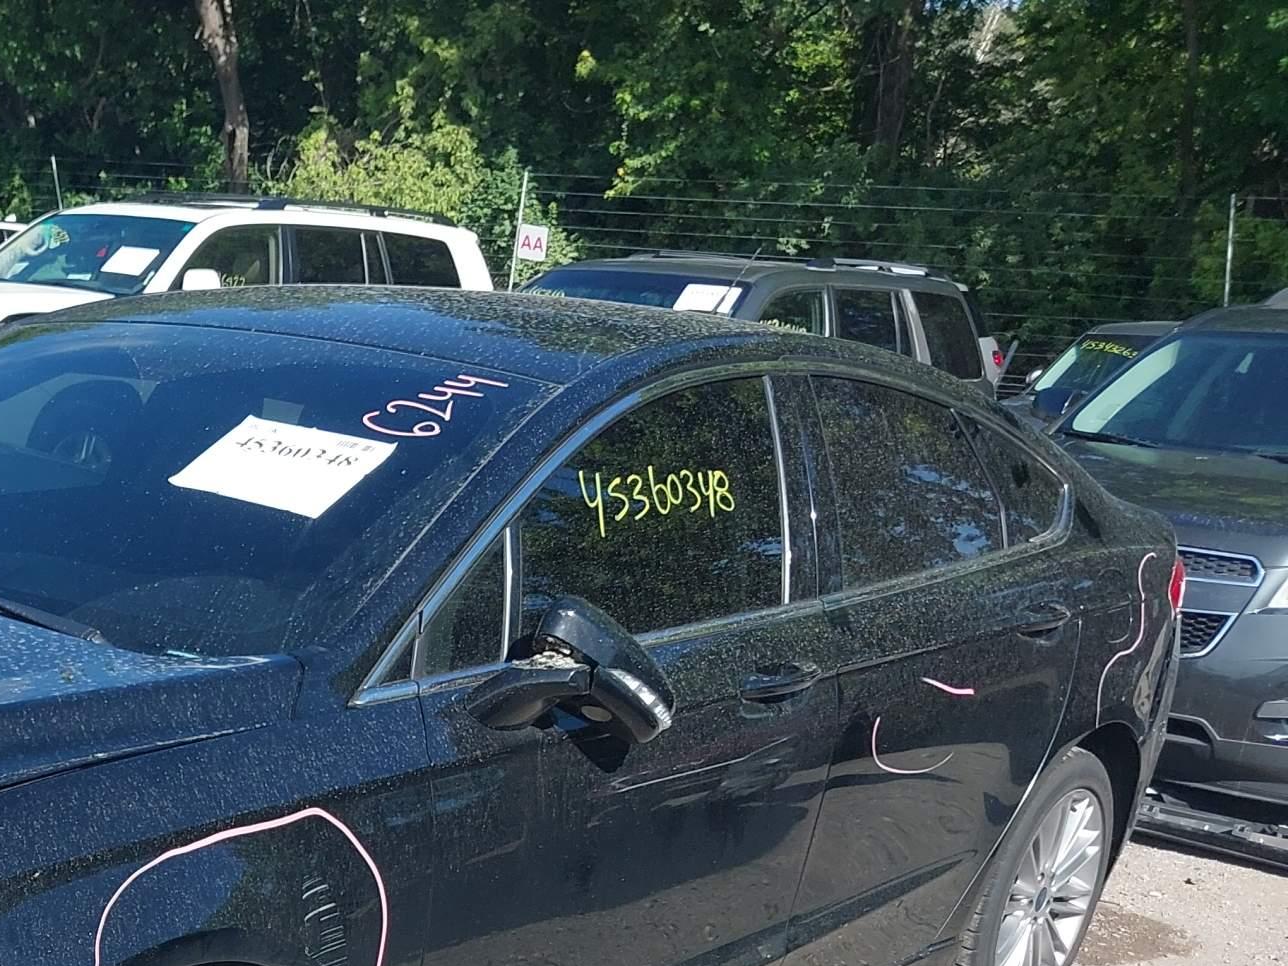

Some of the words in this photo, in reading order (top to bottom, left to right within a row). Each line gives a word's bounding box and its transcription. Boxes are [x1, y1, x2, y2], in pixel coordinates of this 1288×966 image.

[520, 233, 544, 252] AA
[362, 373, 510, 437] 6244
[235, 436, 360, 468] 45360348
[578, 465, 736, 539] 45360348
